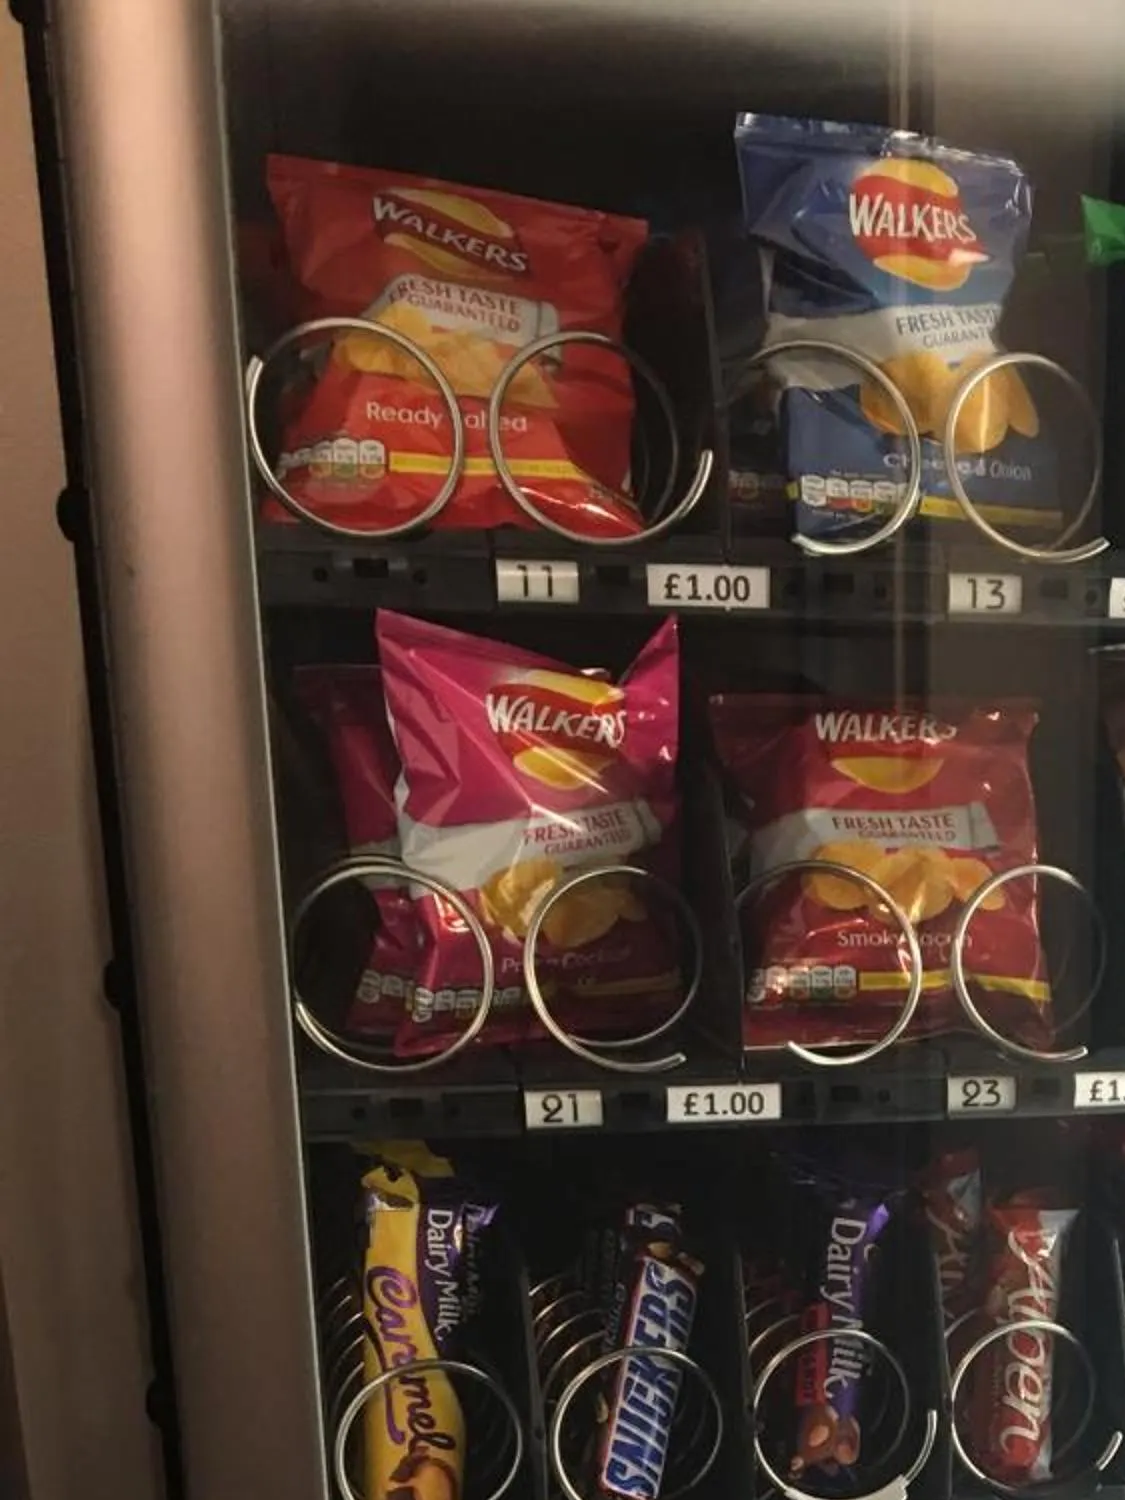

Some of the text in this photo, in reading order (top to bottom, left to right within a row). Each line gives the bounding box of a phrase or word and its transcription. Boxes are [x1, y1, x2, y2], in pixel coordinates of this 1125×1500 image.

[372, 196, 530, 272] WALKERS
[849, 190, 978, 245] WALKERS
[407, 293, 521, 333] GUARANTEED
[458, 287, 519, 316] TASTE
[896, 312, 954, 336] FRESH
[922, 326, 990, 349] GUARANT
[366, 400, 529, 433] Ready aled
[990, 461, 1032, 481] Onion
[517, 564, 554, 599] 11
[664, 573, 750, 603] £1.00
[966, 578, 1007, 609] 13
[485, 693, 629, 747] WALKERS
[814, 711, 958, 744] WALKERS
[522, 809, 630, 845] FRESH TASTE
[831, 813, 955, 831] FRESH TASTE
[837, 930, 974, 951] Smoky acn
[541, 1094, 580, 1123] 21
[683, 1092, 765, 1116] £1.00
[961, 1080, 1000, 1107] 23
[424, 1207, 462, 1341] Dairy Milk
[819, 1216, 868, 1400] Dairy Milk
[1000, 1229, 1056, 1454] Alpen
[366, 1265, 456, 1462] Caramel
[606, 1258, 698, 1500] SNICKERS
